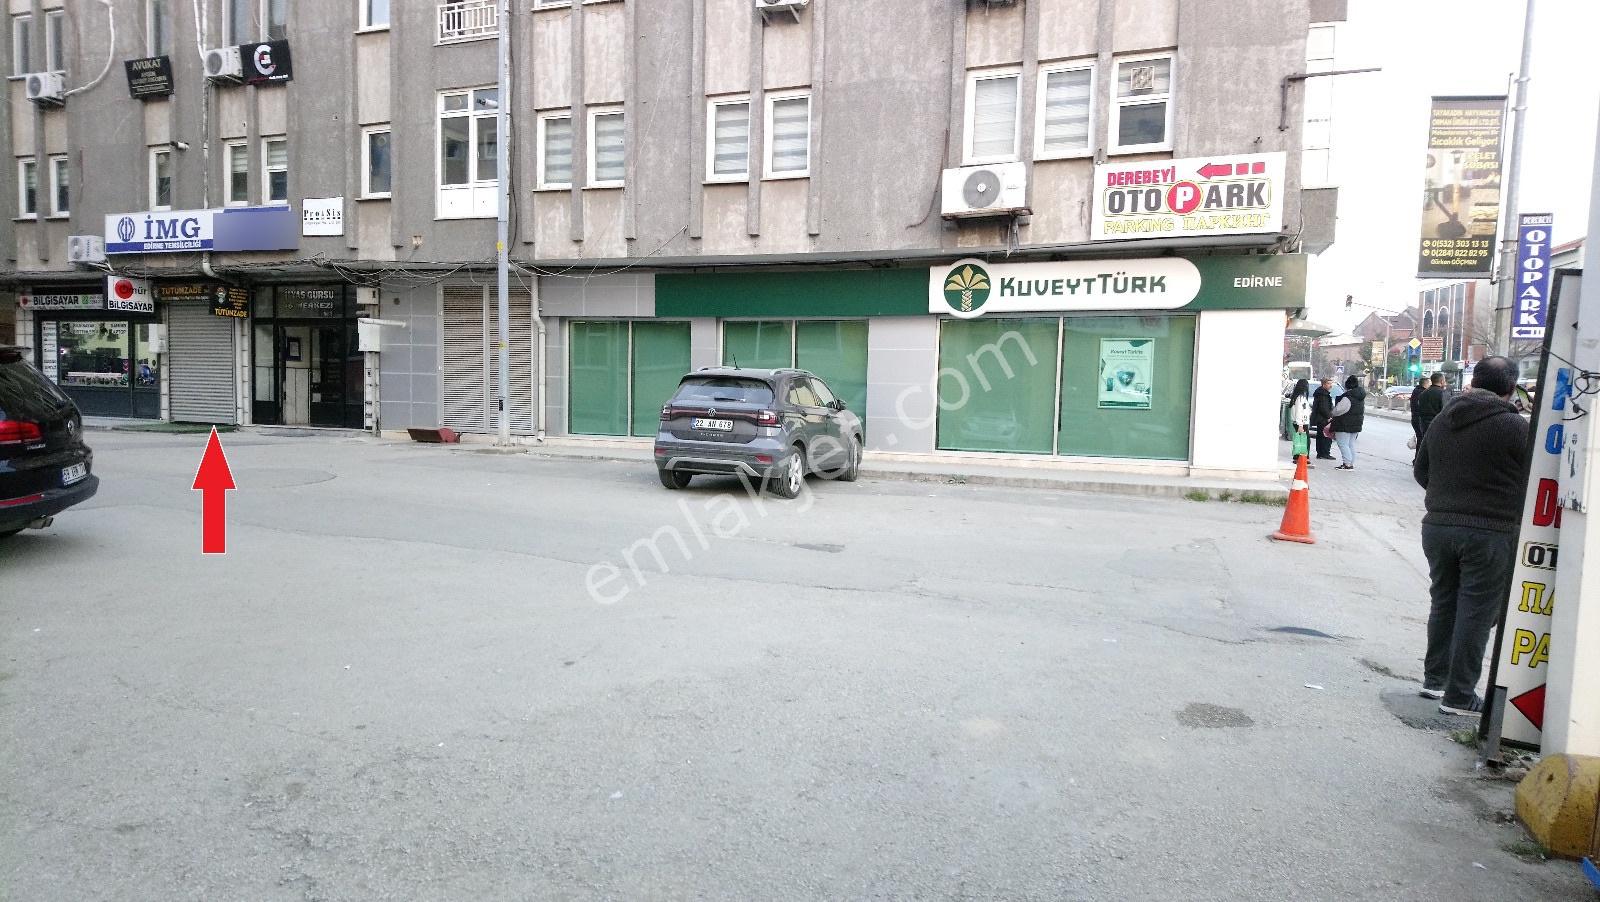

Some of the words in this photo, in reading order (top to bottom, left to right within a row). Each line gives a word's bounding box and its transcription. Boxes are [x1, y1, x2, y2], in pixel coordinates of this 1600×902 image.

[132, 59, 161, 70] AVUKAT
[1431, 136, 1464, 146] Sıcaklık
[1464, 137, 1498, 147] Geliyor!
[1104, 217, 1175, 234] PARKING
[1455, 240, 1470, 248] 303
[1454, 249, 1468, 257] 822
[1468, 249, 1478, 257] 82
[1479, 249, 1488, 257] 95
[1233, 274, 1283, 288] EDİRNE
[1520, 229, 1547, 325] OTOPARK
[307, 288, 334, 299] GÜRSU
[695, 419, 704, 427] 22
